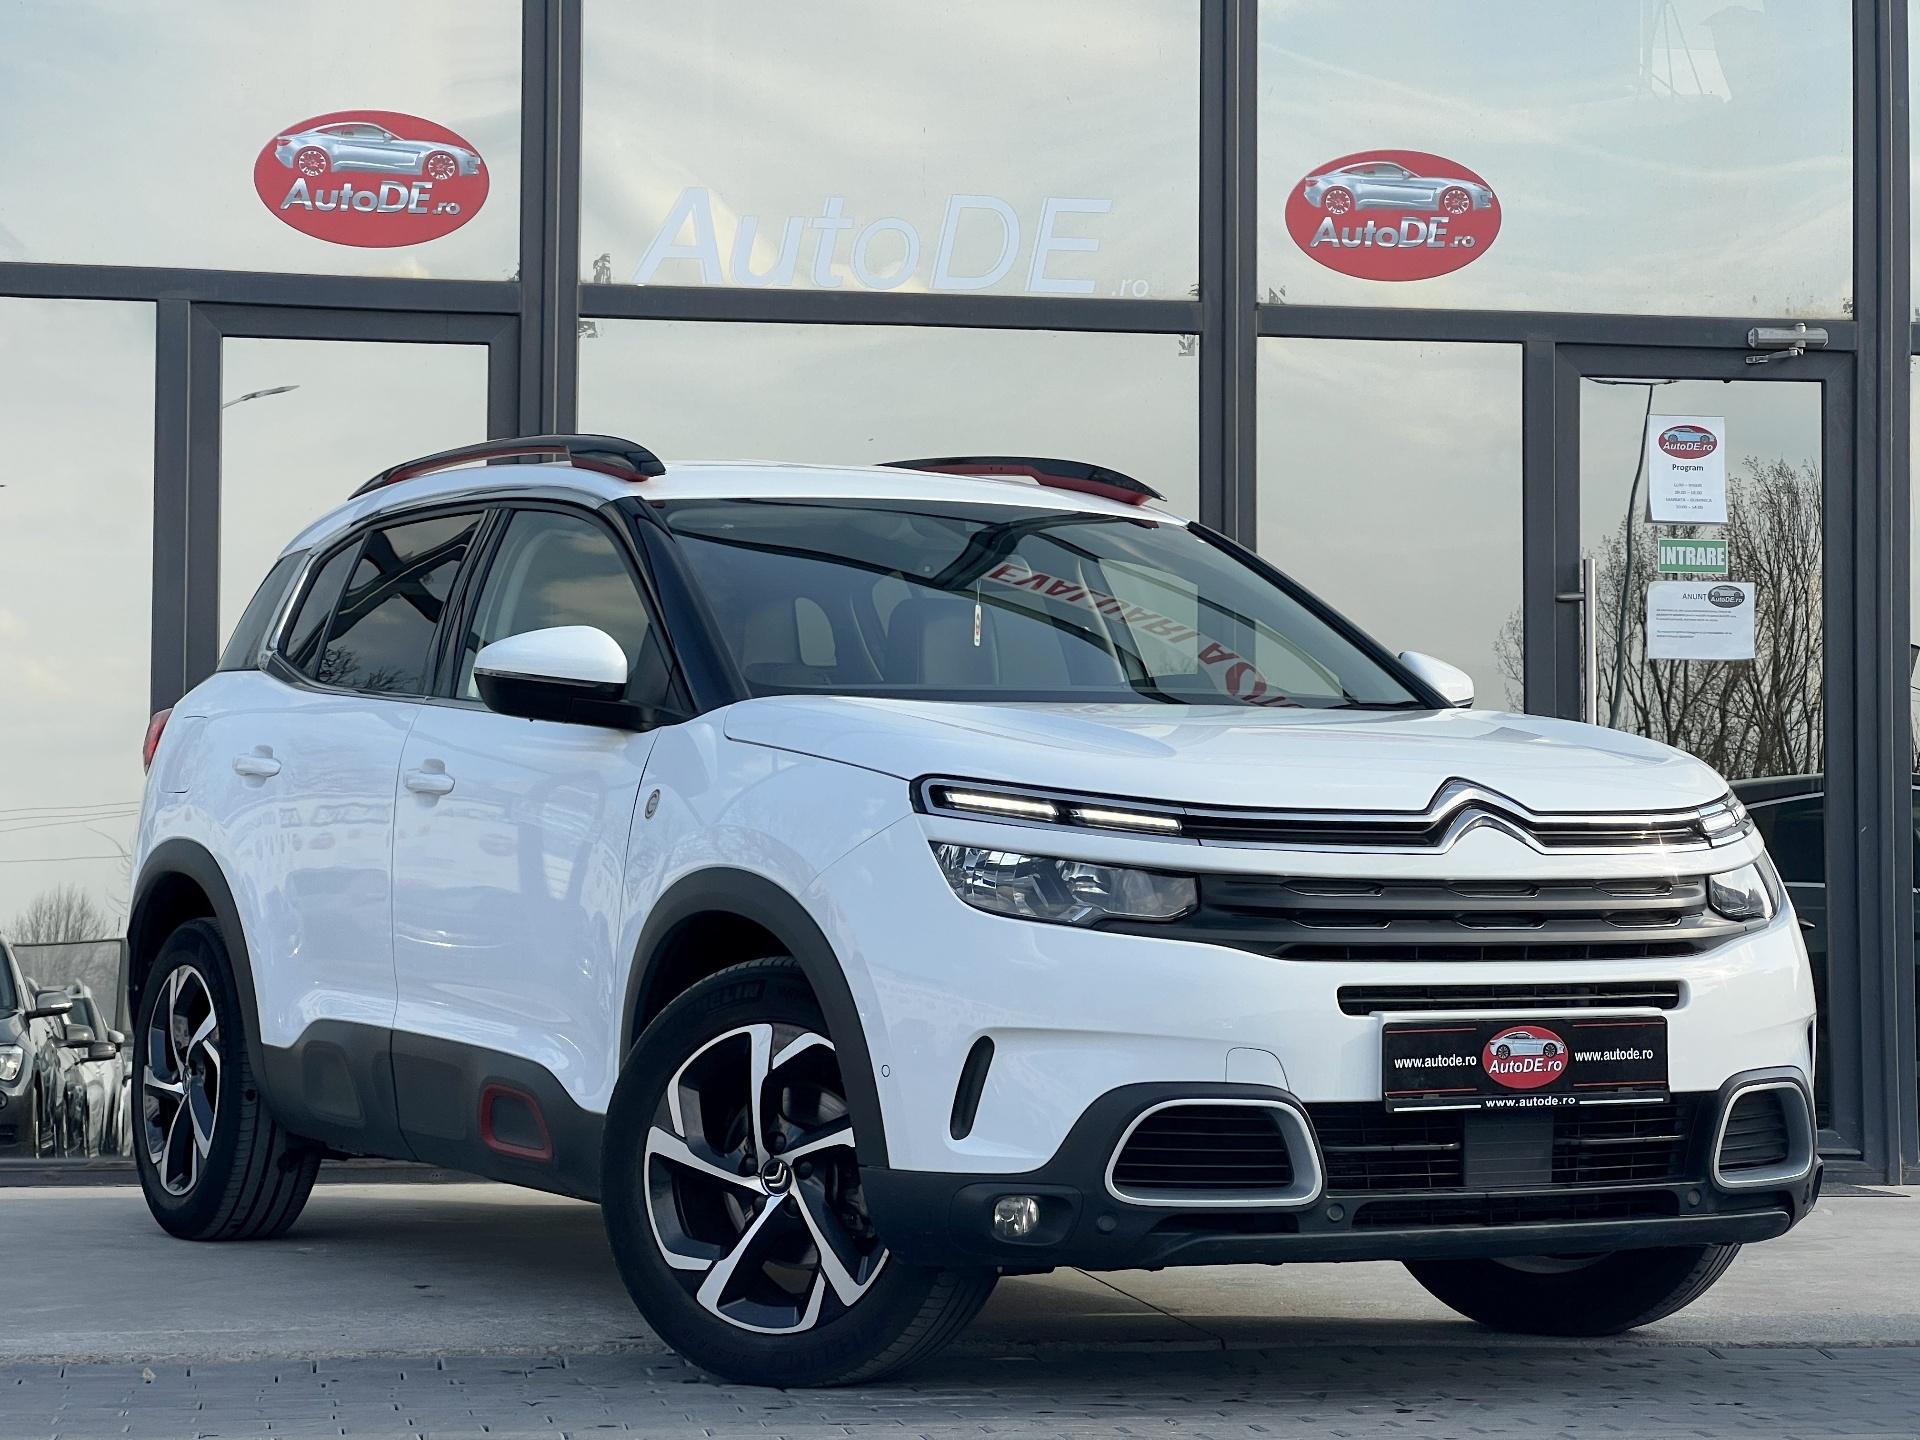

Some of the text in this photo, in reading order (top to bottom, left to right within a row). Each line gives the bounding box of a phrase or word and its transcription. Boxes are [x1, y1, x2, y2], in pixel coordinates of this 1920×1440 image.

[1663, 441, 1713, 451] AutoDE.ro
[1672, 463, 1704, 472] Program
[1661, 547, 1725, 566] INTRARE
[1394, 1055, 1477, 1069] www.autode.ro
[1574, 1048, 1654, 1062] www.autode.ro
[1489, 1058, 1563, 1074] AutoDE.ro
[1485, 1096, 1576, 1108] www.autode.ro
